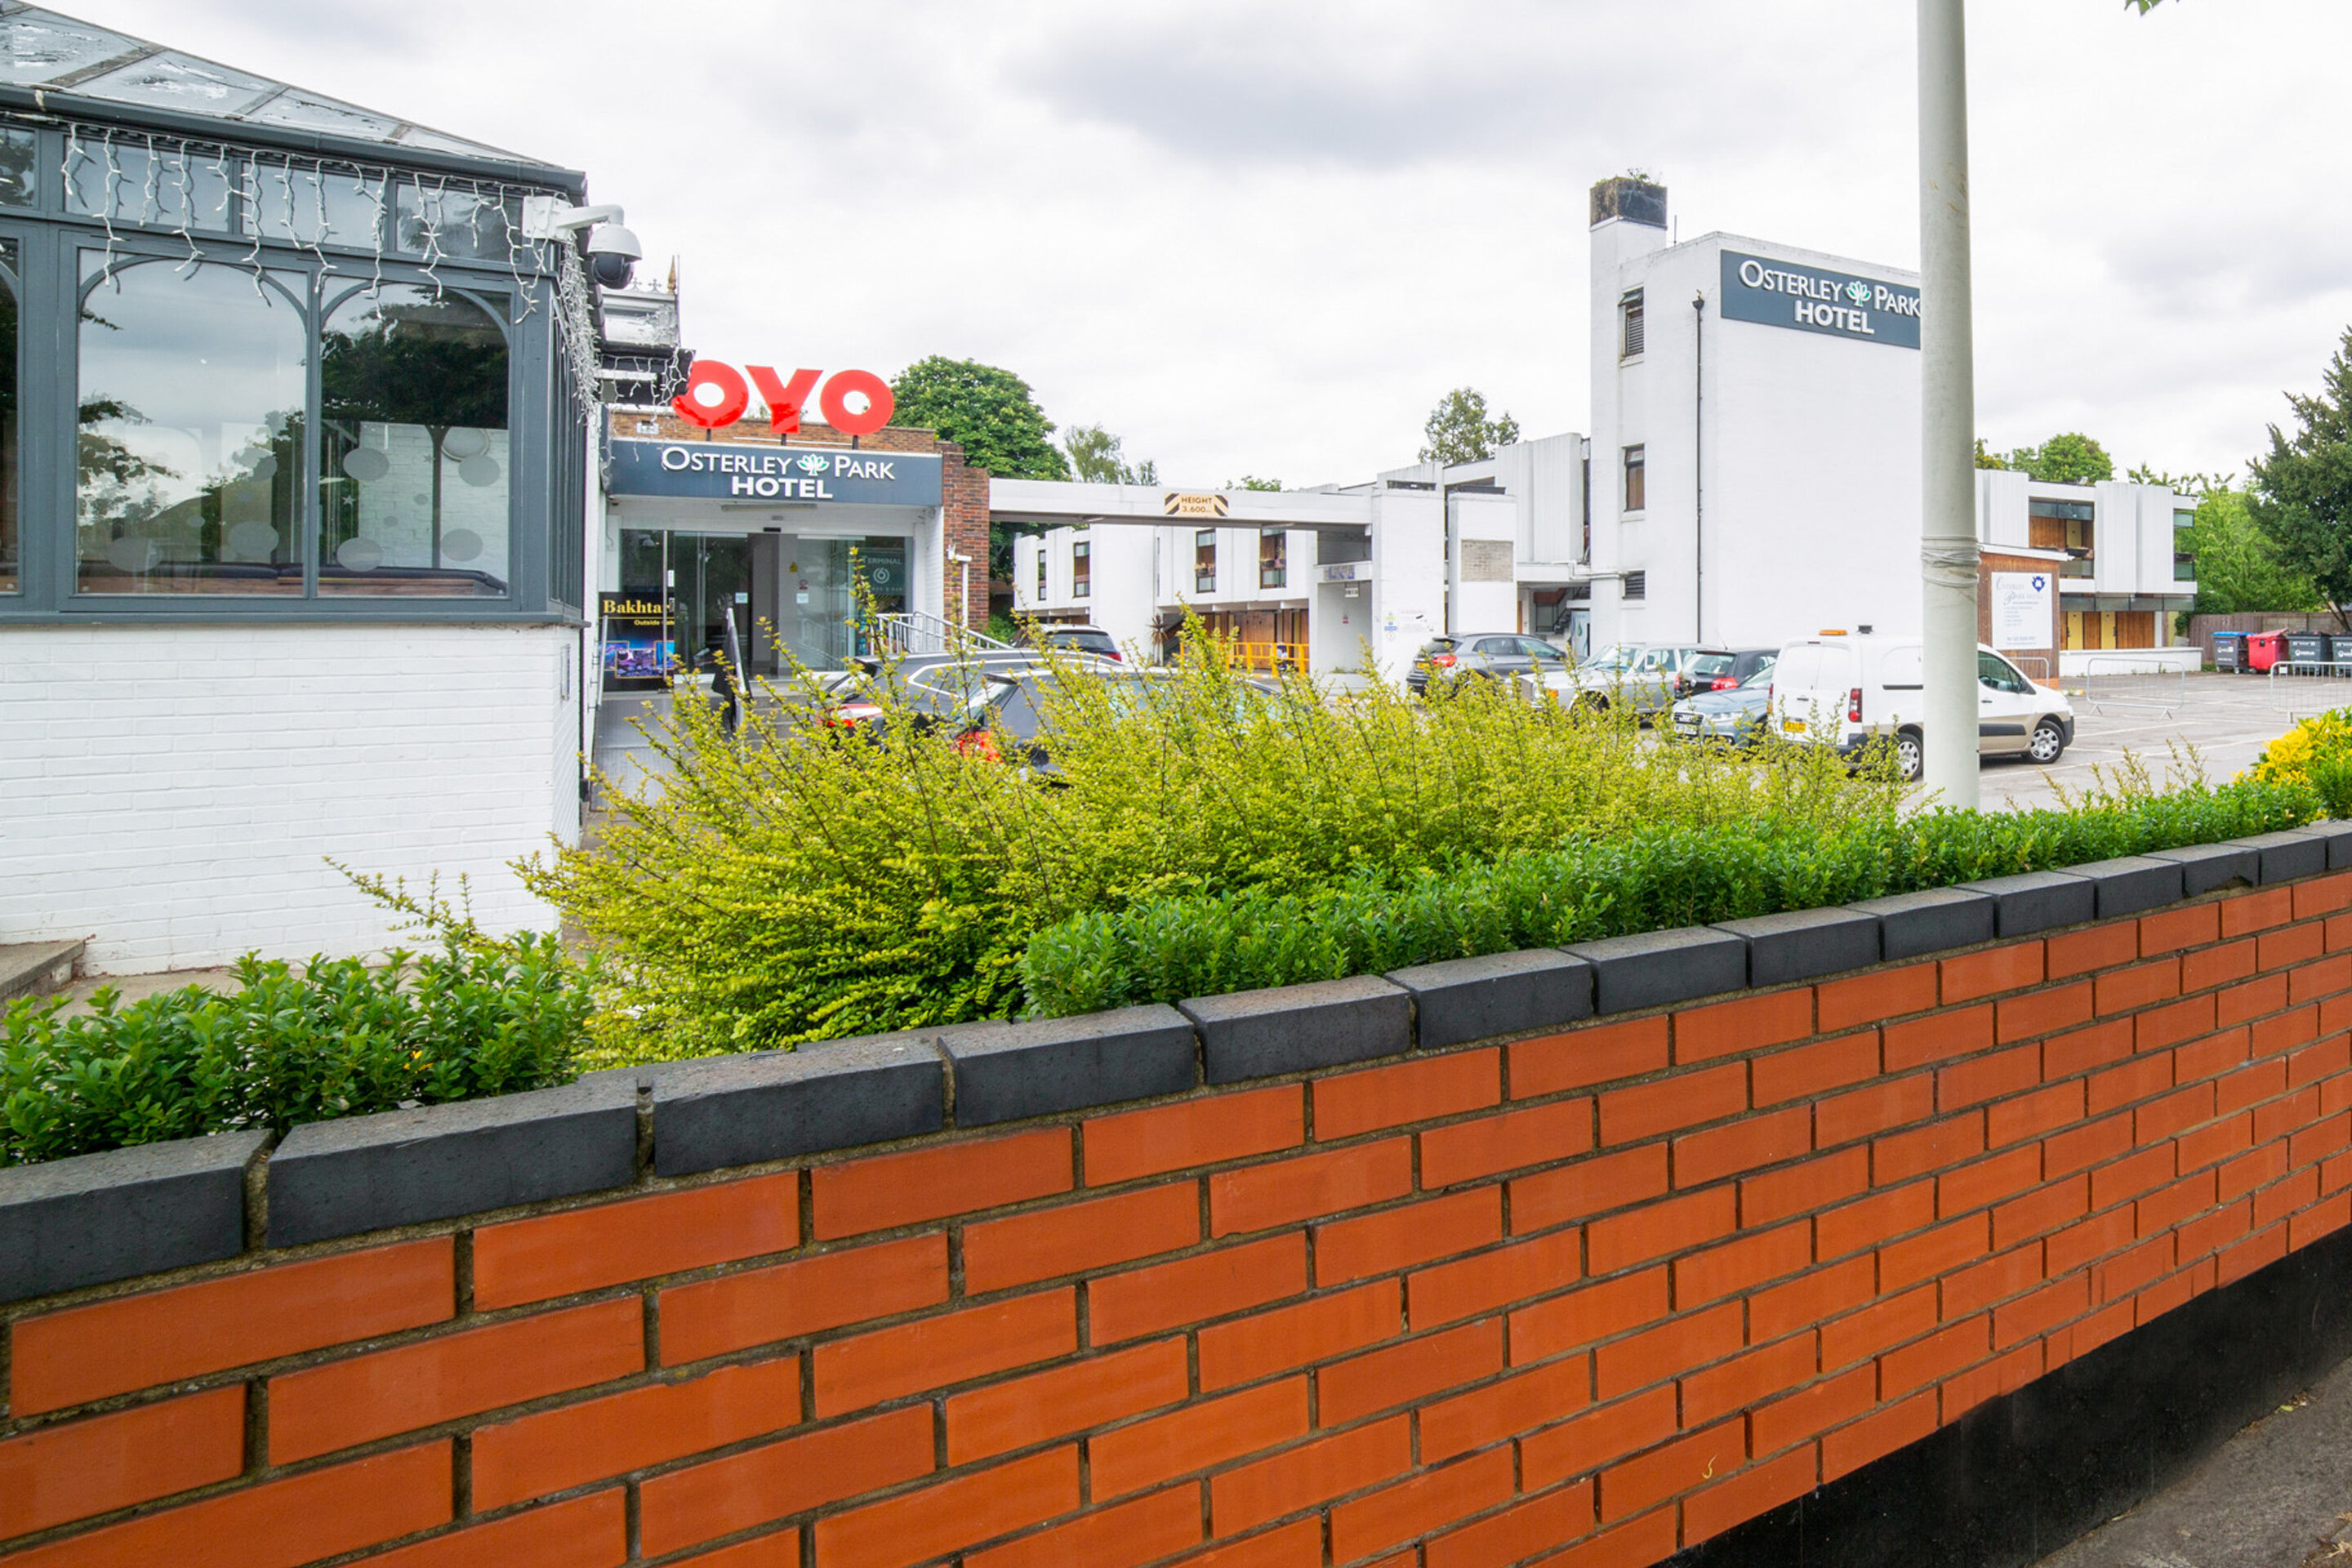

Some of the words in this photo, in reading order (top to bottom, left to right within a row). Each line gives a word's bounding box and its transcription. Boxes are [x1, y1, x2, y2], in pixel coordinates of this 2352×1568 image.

[1739, 260, 1843, 301] OSTERLEY
[1874, 285, 1922, 317] PARK
[1794, 300, 1875, 334] HOTEL
[671, 360, 894, 436] OYO
[662, 446, 792, 475] OSTERLEY
[834, 455, 895, 480] PARK
[731, 475, 833, 499] HOTEL
